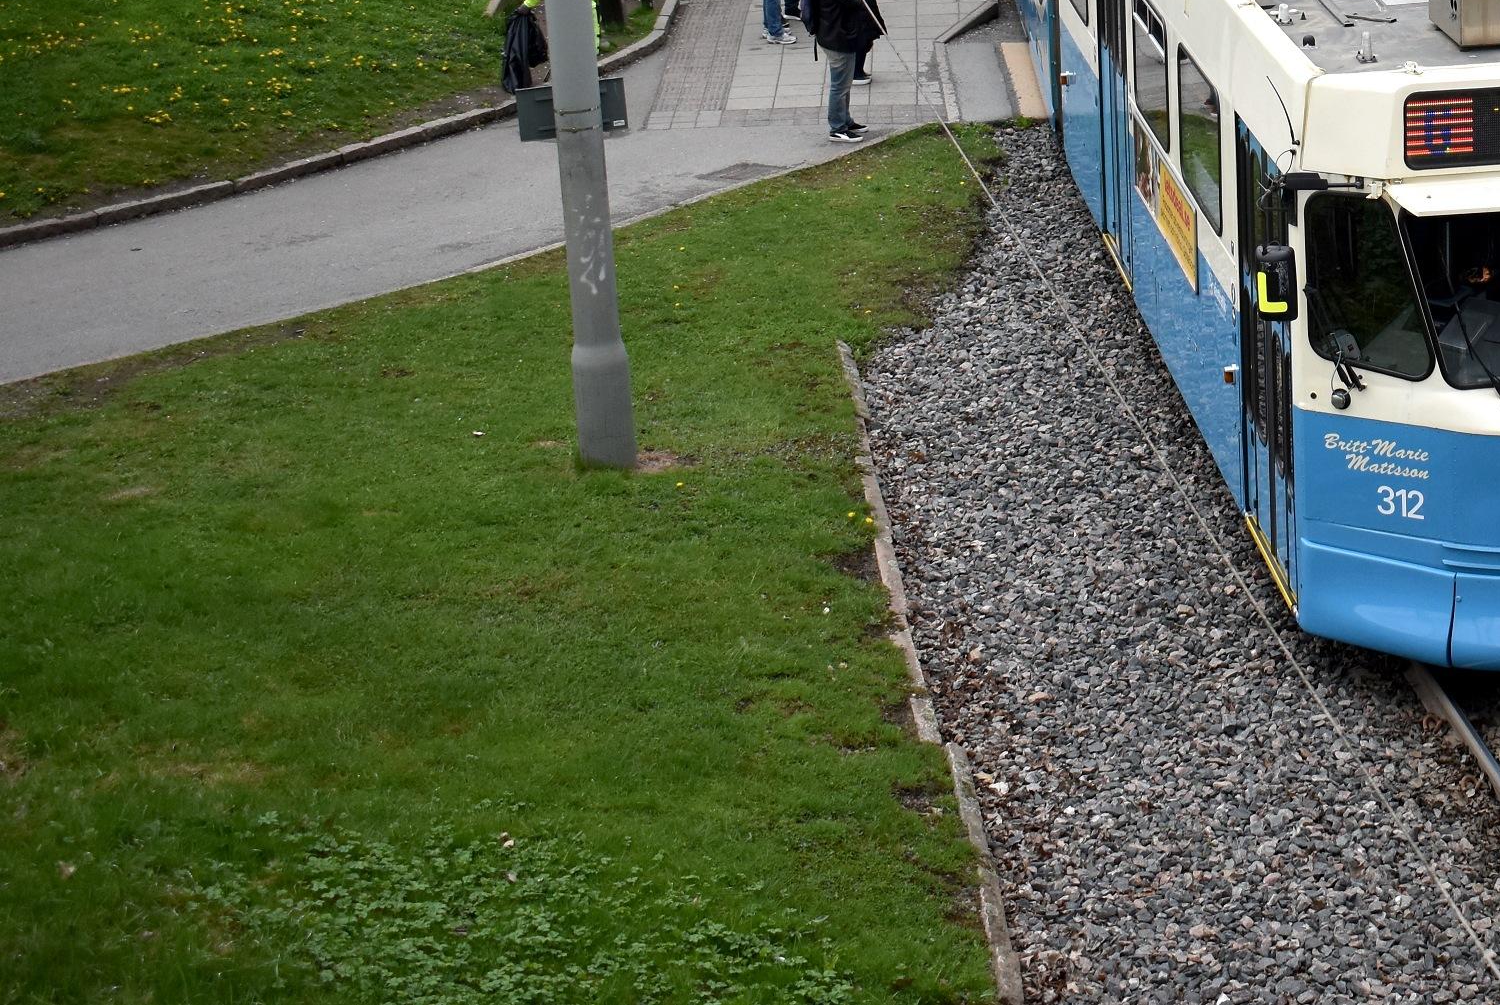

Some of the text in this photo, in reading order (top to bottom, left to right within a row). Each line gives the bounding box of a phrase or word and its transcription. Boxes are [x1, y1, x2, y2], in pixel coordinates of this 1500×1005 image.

[1324, 433, 1429, 462] Britt-Marie
[1345, 453, 1430, 479] Mattsson
[1377, 485, 1425, 520] 312
